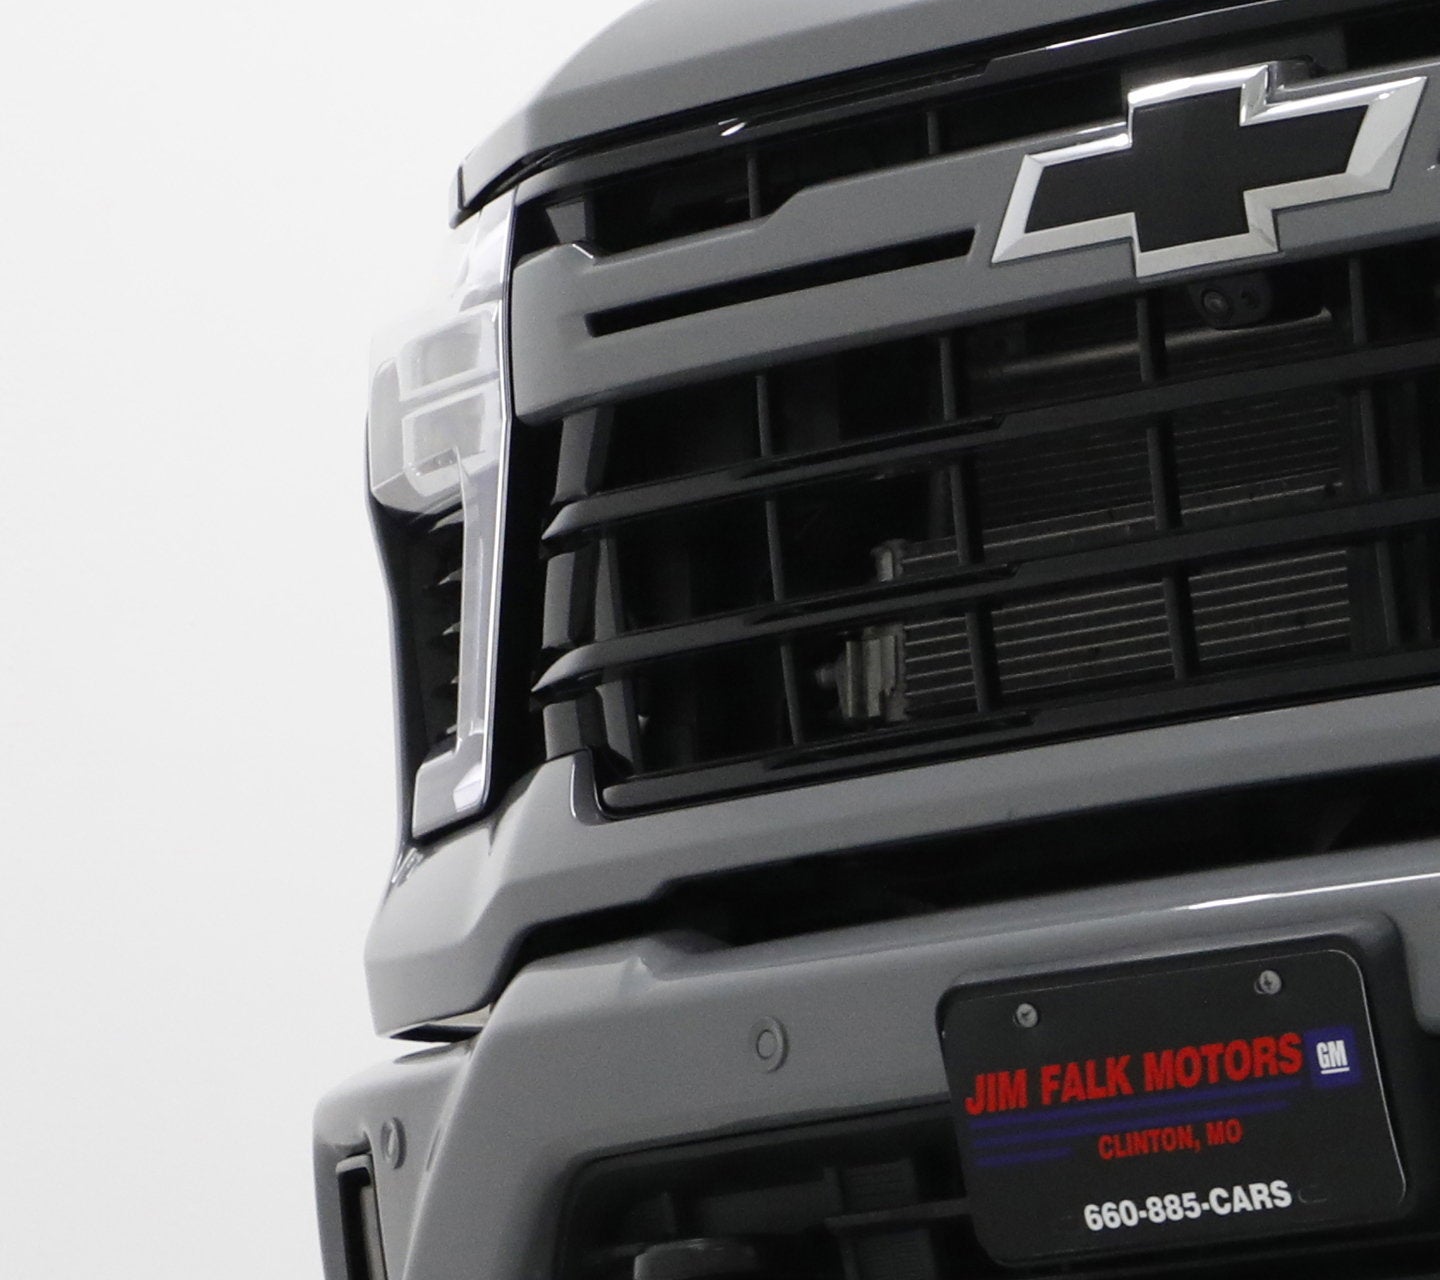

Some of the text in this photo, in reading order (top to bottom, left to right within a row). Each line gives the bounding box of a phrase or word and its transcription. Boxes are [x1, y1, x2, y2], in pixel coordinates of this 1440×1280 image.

[965, 1032, 1305, 1116] JIM FALK MOTORS
[1315, 1039, 1349, 1071] GM
[1098, 1118, 1244, 1160] CLINTON, MO
[1083, 1178, 1293, 1232] 660-885-CARS
